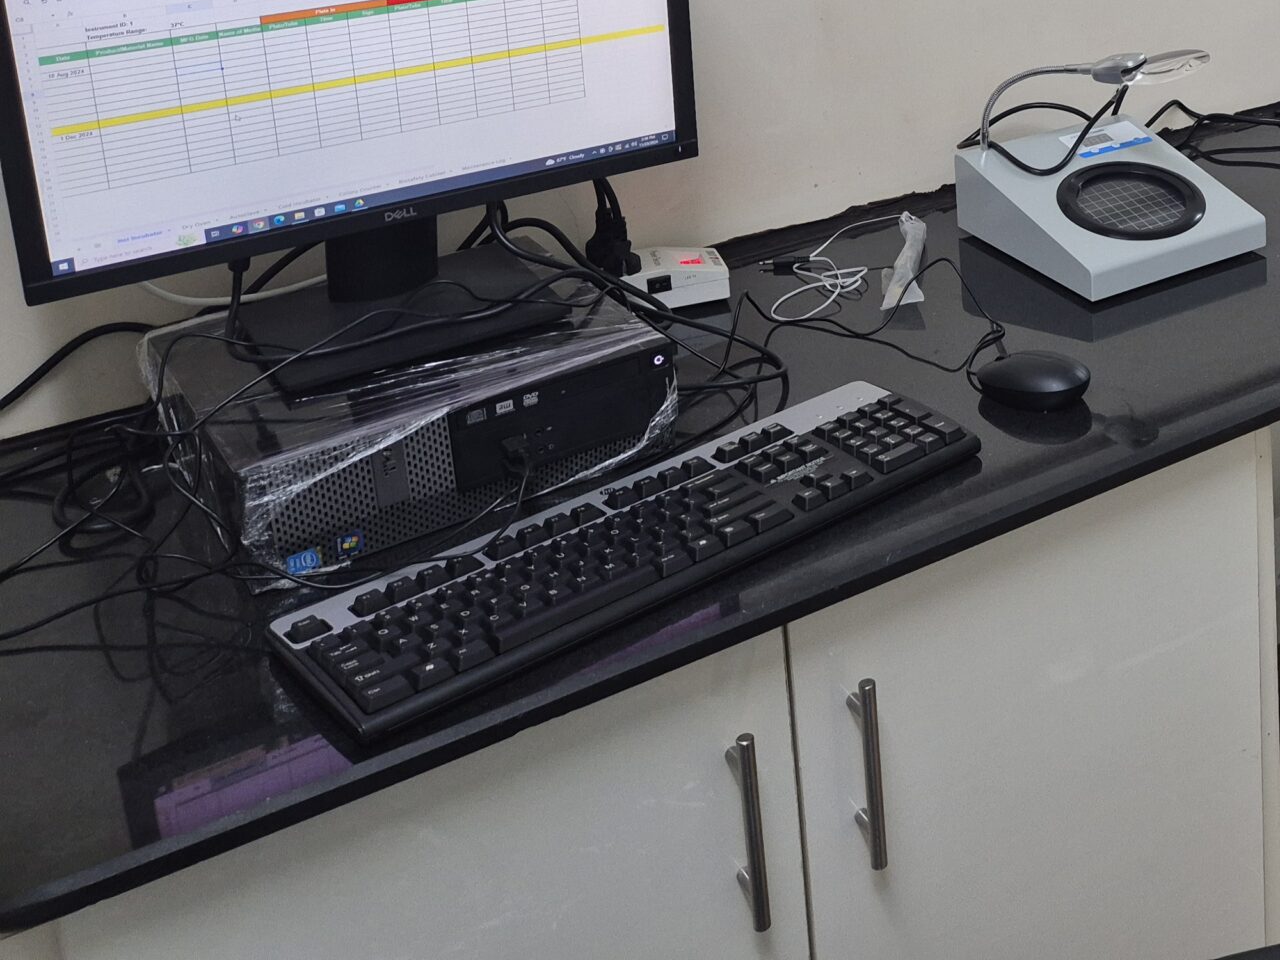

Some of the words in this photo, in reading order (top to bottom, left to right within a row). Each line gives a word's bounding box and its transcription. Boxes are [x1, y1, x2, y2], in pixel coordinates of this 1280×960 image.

[84, 23, 119, 33] Instrument
[87, 31, 126, 41] Temperature
[55, 54, 71, 62] Date
[65, 133, 78, 141] Dec
[384, 207, 417, 222] DELL
